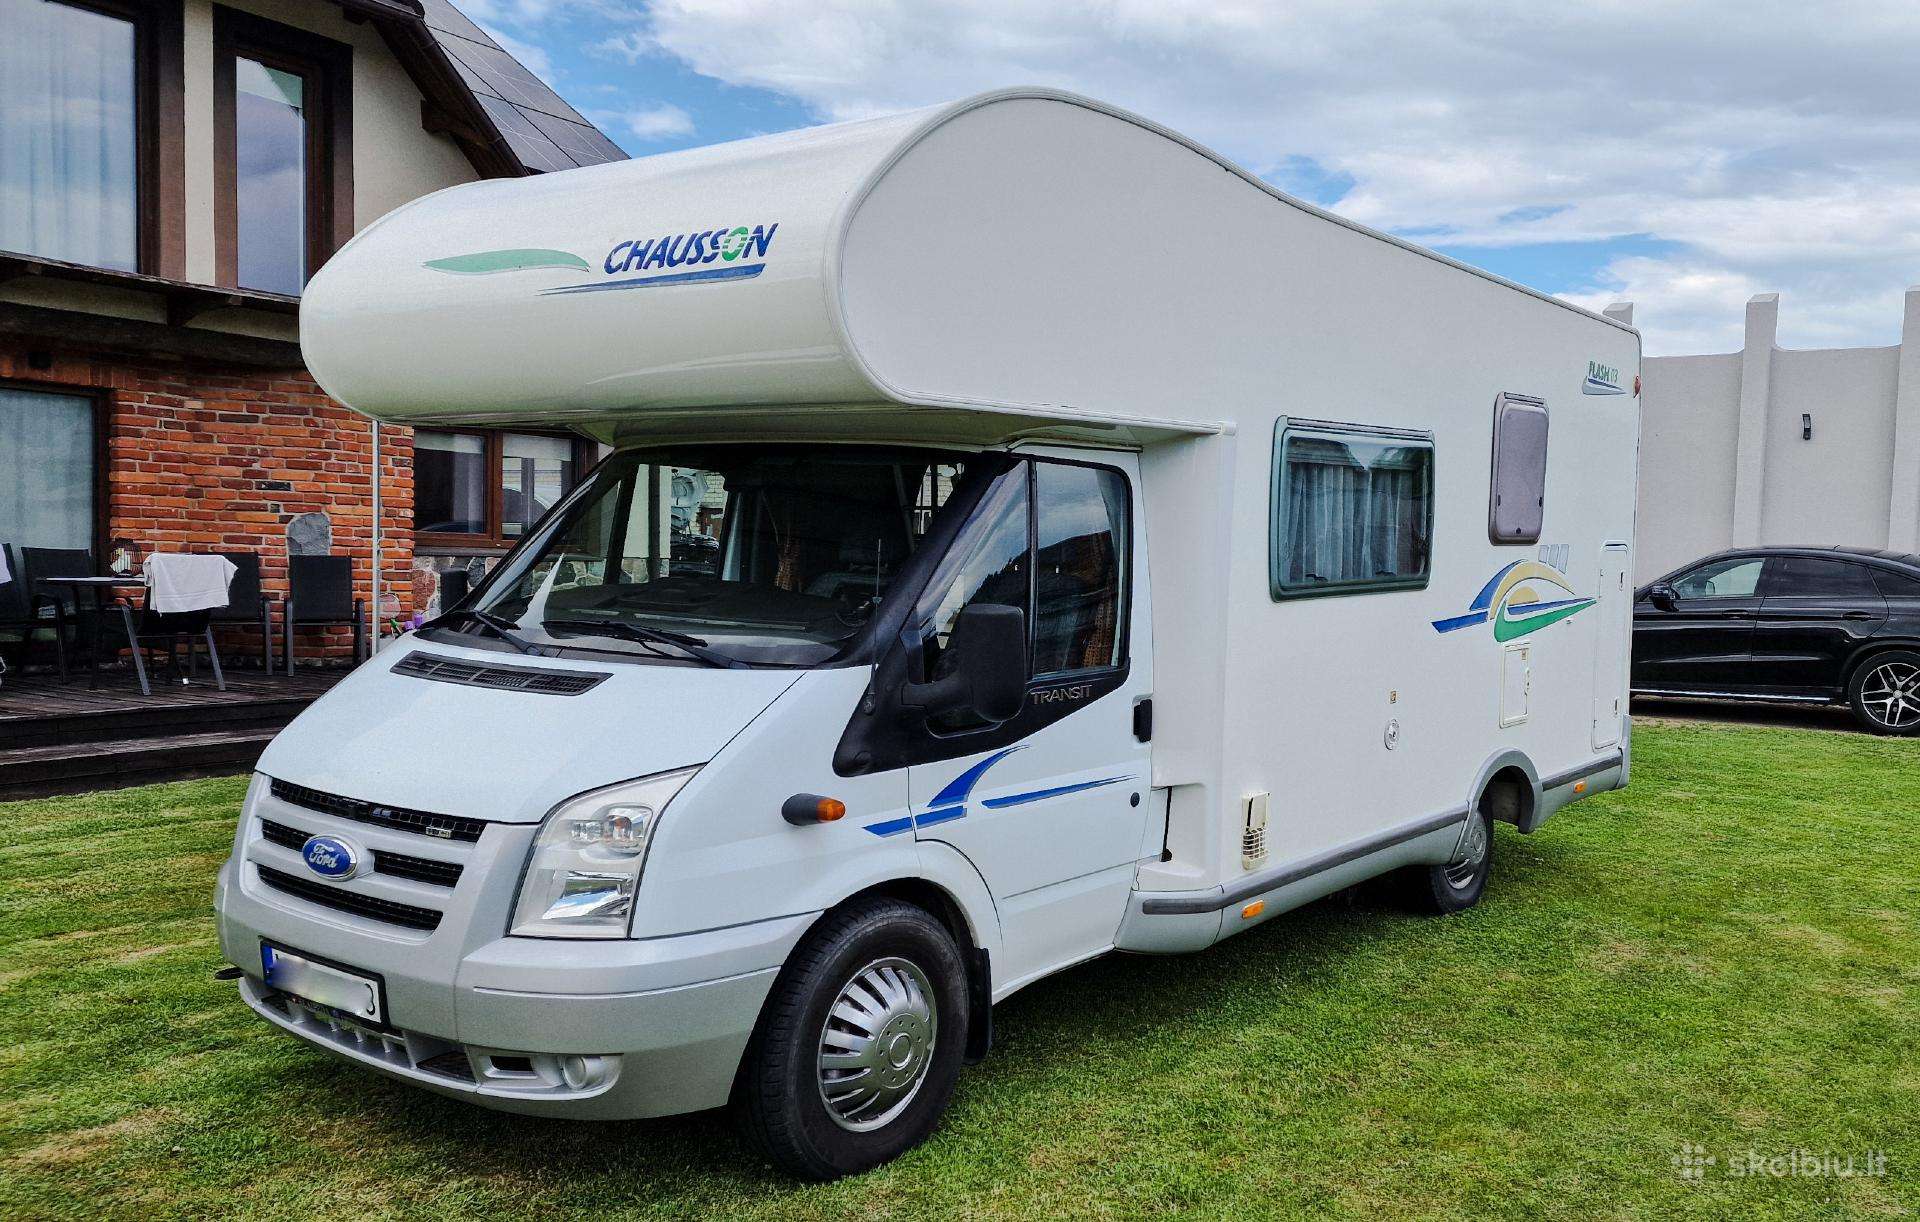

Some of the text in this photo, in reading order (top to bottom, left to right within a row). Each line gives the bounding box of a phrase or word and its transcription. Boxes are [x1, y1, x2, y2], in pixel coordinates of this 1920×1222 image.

[603, 222, 779, 275] CHAUSSON
[1030, 684, 1093, 705] TRANSIT
[308, 843, 340, 868] Ford
